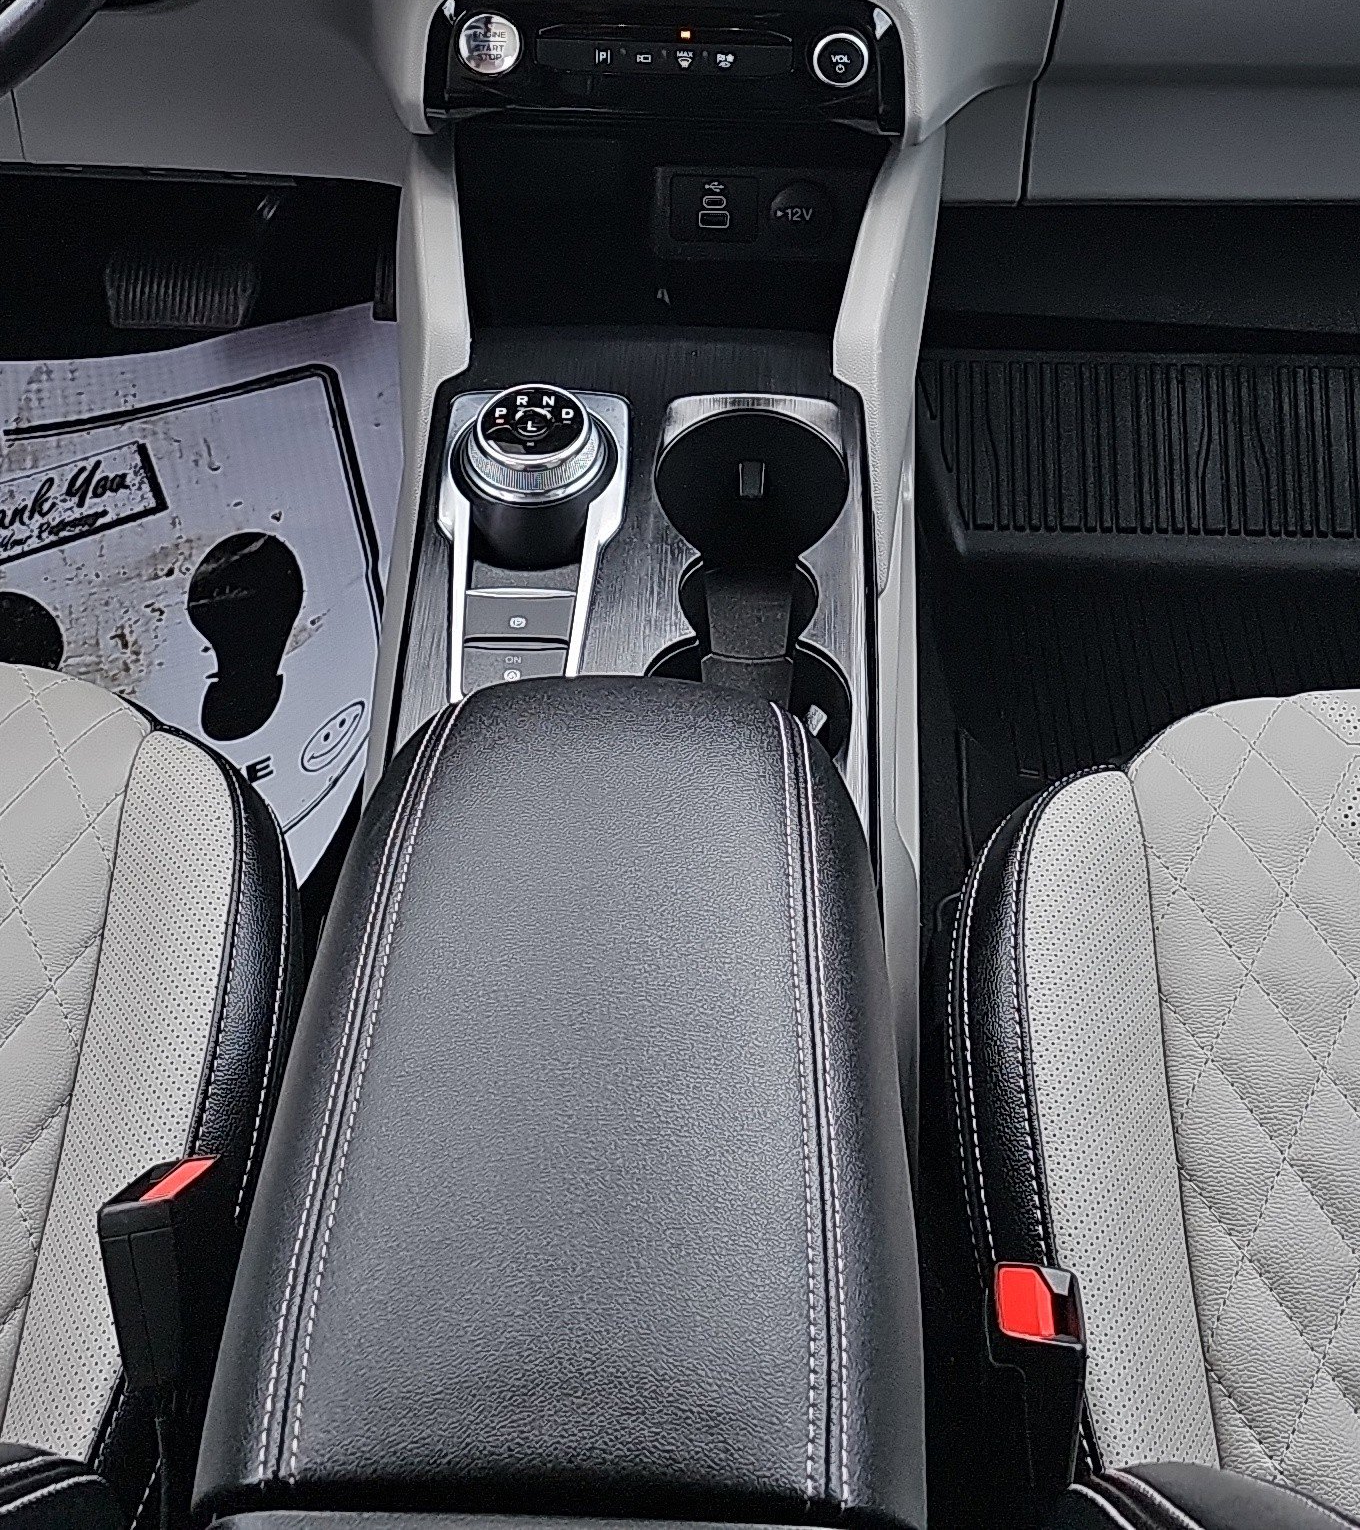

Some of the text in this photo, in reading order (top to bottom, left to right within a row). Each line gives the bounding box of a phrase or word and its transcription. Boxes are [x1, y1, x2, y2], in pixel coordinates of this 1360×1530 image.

[472, 31, 507, 39] ENGINE
[474, 44, 504, 53] START
[676, 50, 693, 58] MAX
[477, 53, 503, 61] STOP
[830, 54, 850, 63] VOL
[785, 208, 813, 221] 12V
[516, 395, 529, 406] R
[542, 395, 556, 407] N
[495, 407, 507, 418] P
[561, 408, 575, 419] D
[526, 420, 537, 431] L
[66, 459, 132, 509] You
[505, 656, 522, 664] ON
